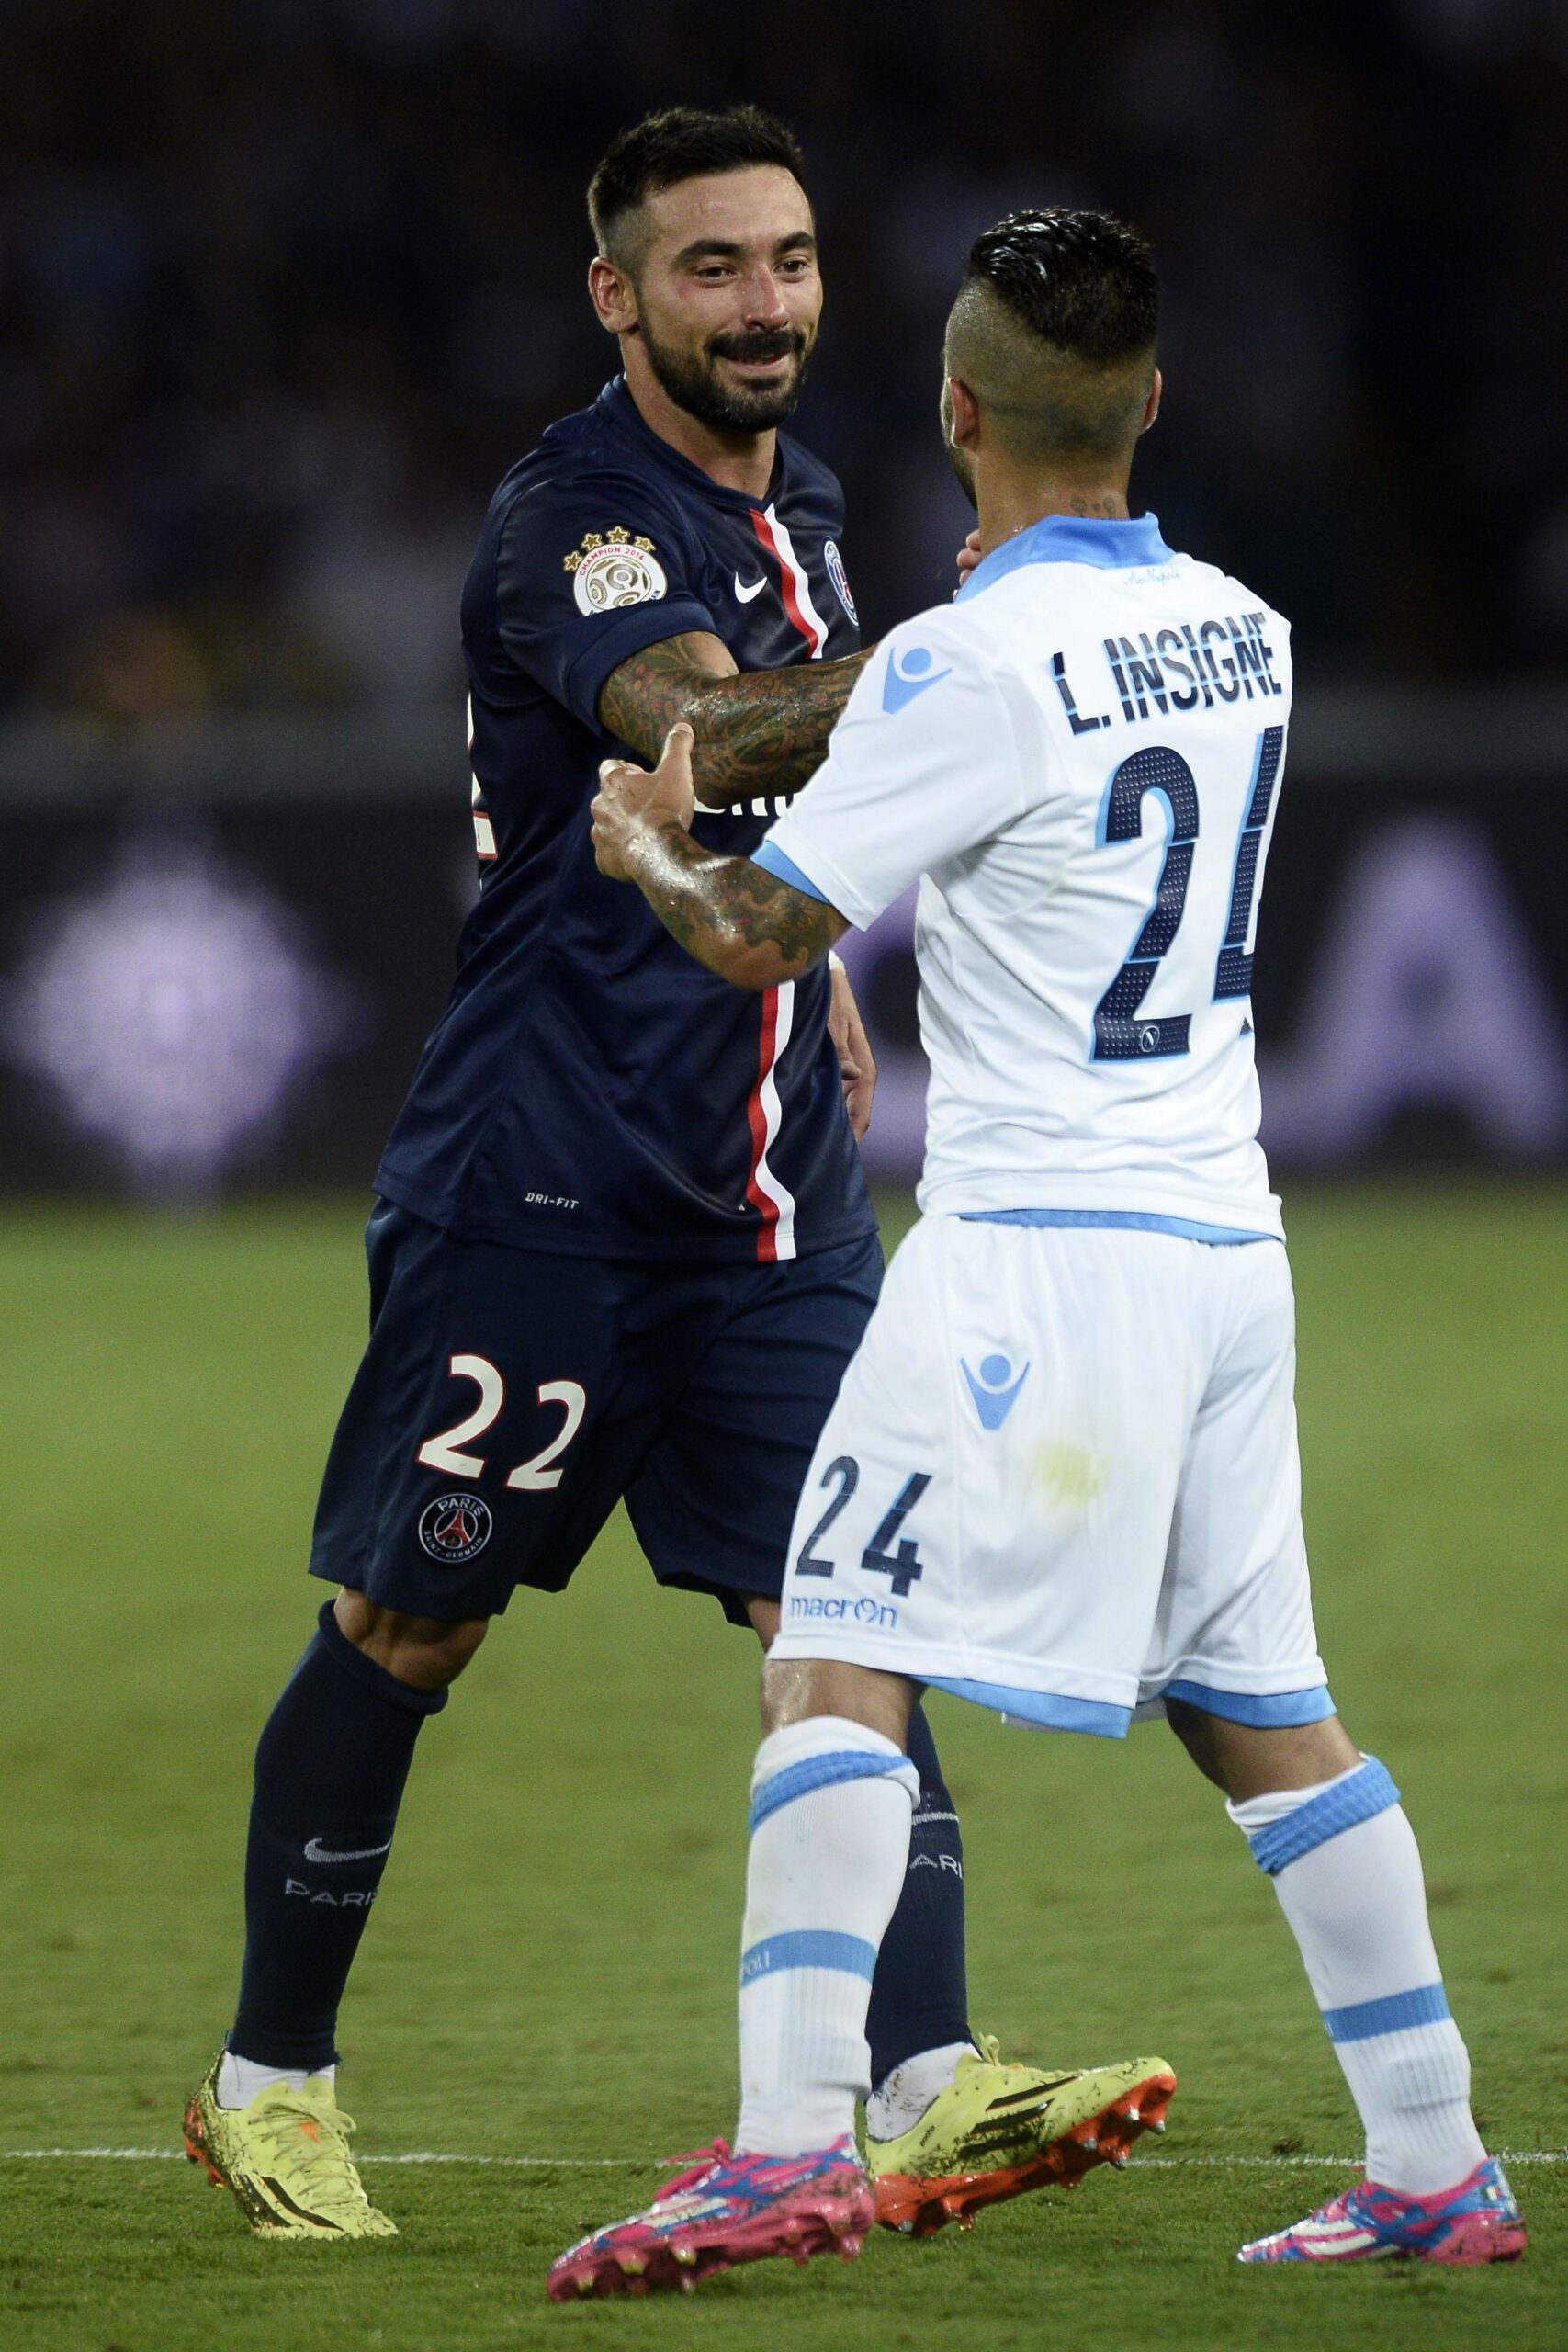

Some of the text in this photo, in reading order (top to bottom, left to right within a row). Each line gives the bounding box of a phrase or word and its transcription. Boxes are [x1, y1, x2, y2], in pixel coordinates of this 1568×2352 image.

[580, 546, 645, 576] CHAMPION 2014
[1050, 611, 1282, 735] L. INSIGNE
[525, 1192, 579, 1209] DRI-FIT
[416, 1353, 586, 1490] 22
[437, 1497, 484, 1517] PARIS
[795, 1454, 933, 1598] 24
[791, 1597, 897, 1628] macron
[909, 1853, 963, 1880] ARI
